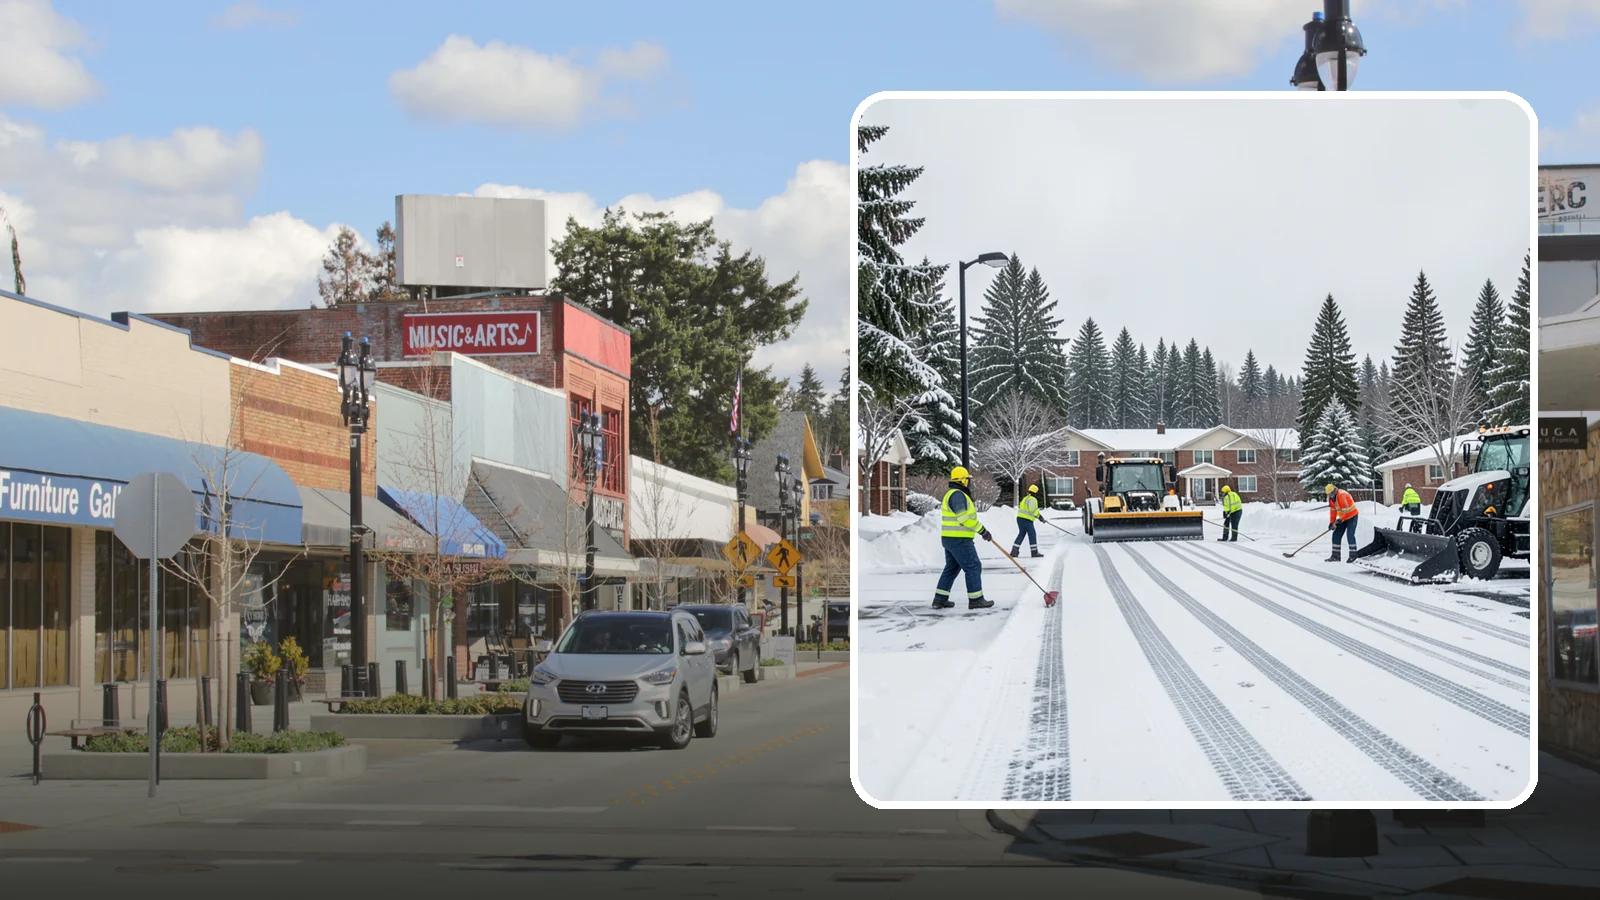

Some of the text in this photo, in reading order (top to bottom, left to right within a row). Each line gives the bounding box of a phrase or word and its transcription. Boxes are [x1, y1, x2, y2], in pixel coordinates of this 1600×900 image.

[1540, 427, 1577, 436] UGA
[0, 471, 79, 515] Furniture
[453, 563, 479, 574] SUSHI
